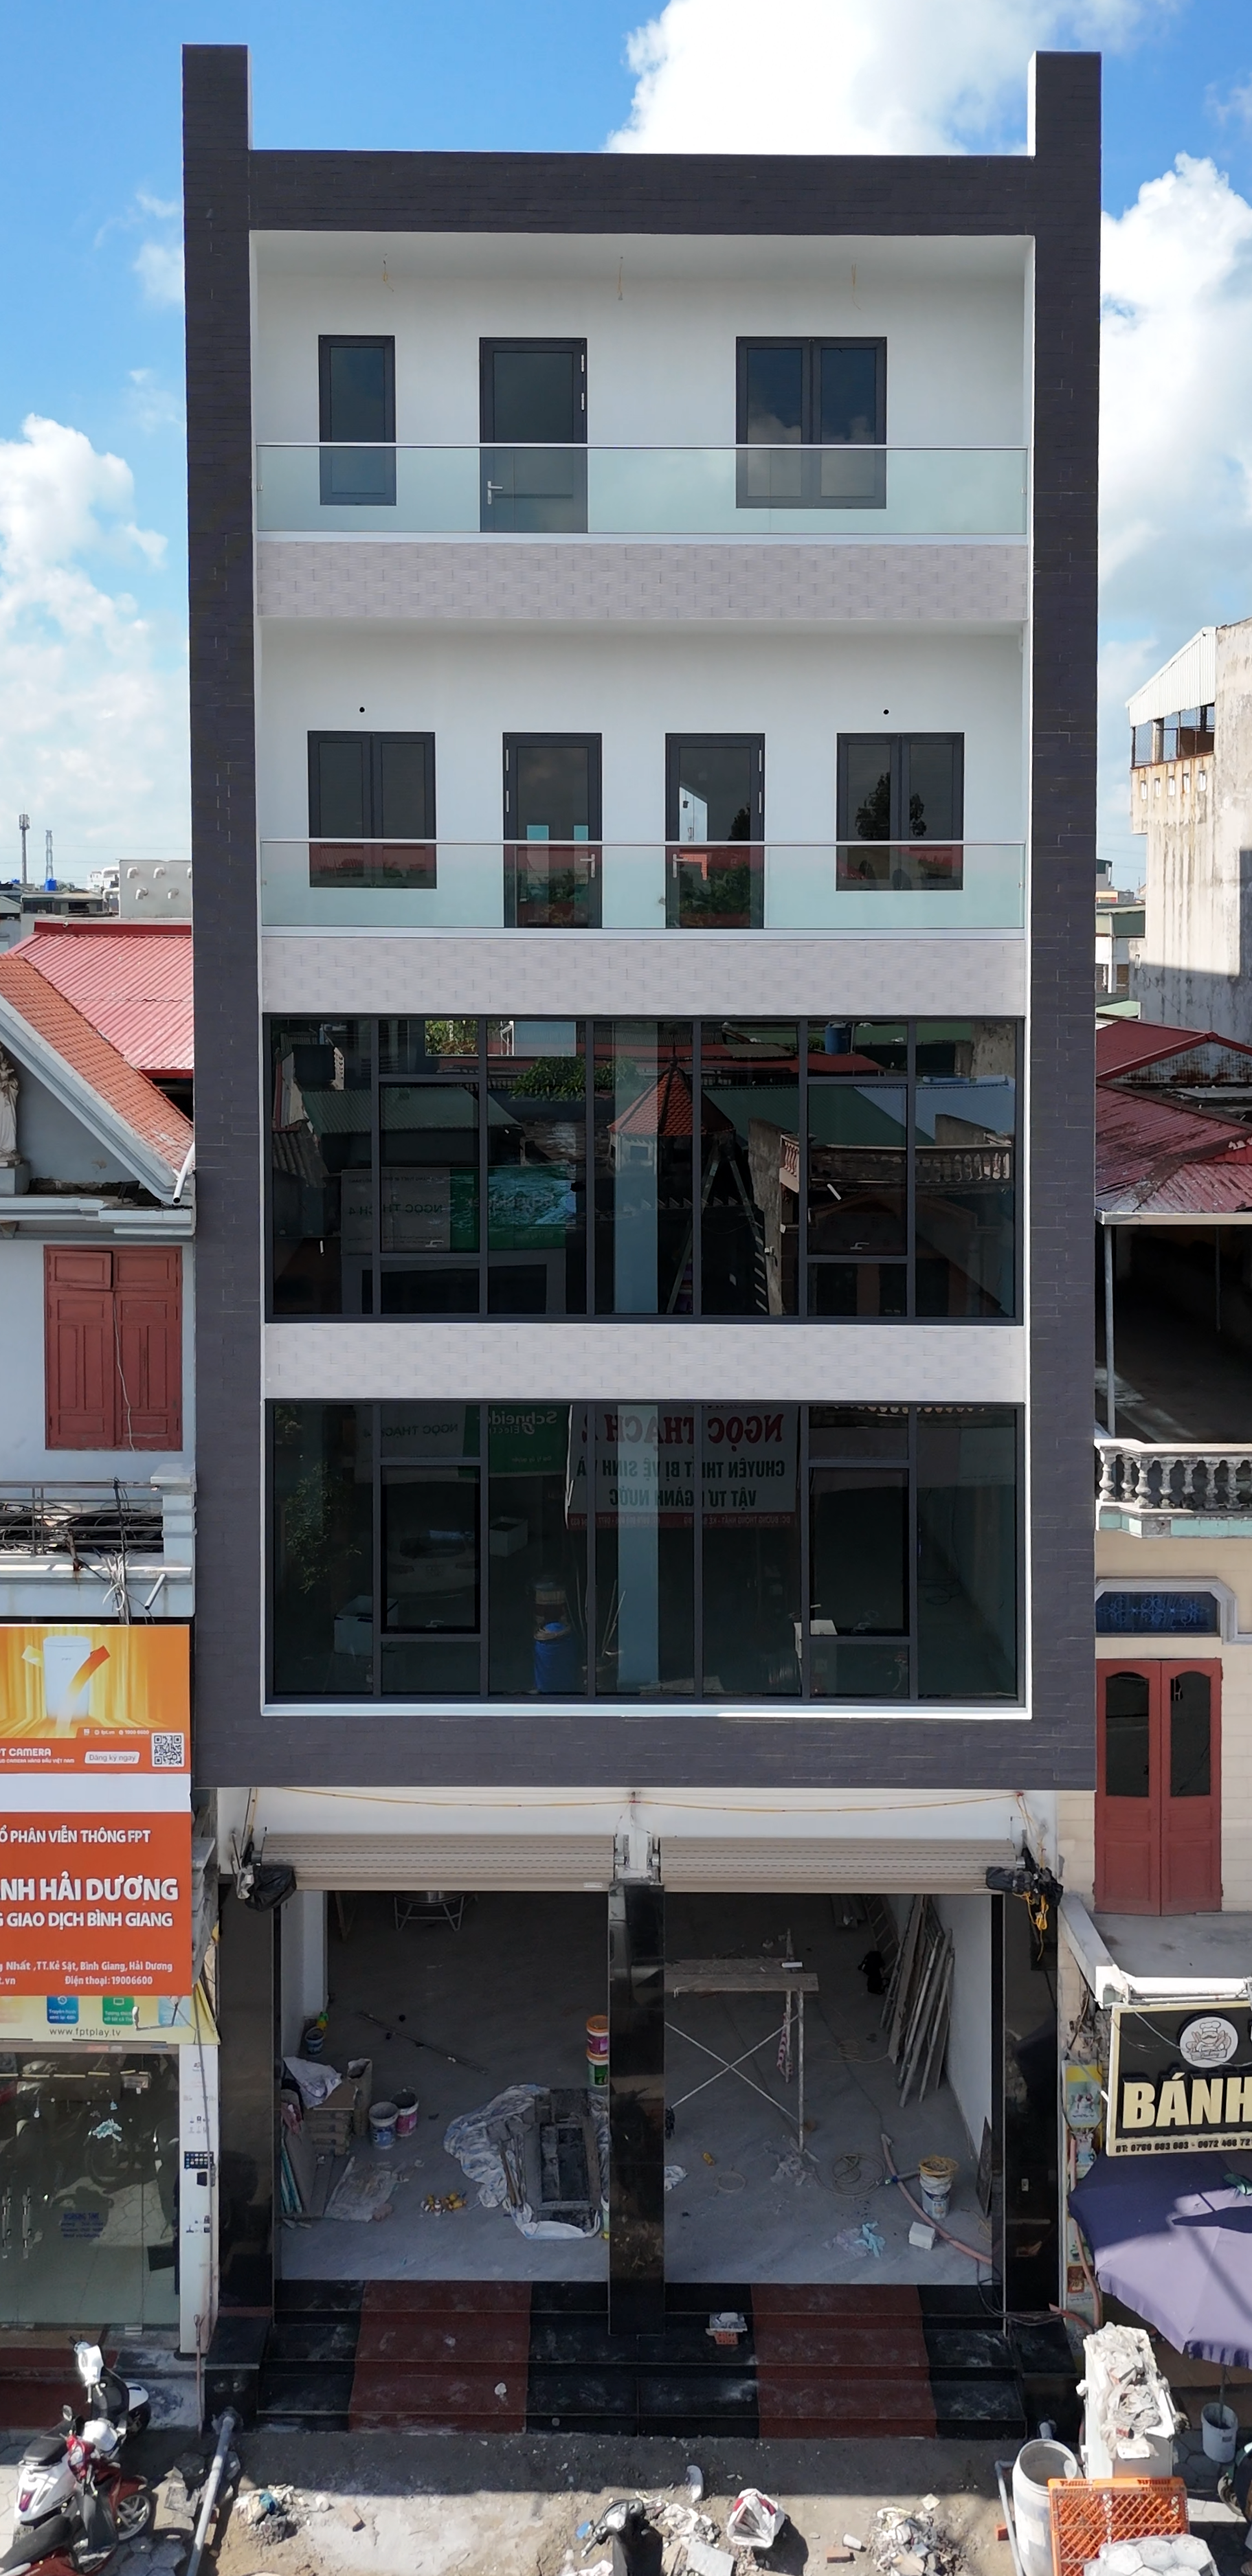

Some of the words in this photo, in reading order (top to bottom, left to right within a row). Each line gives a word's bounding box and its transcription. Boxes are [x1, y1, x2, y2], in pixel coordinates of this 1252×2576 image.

[0, 1748, 6, 1756] T
[9, 1748, 52, 1756] CAMERA
[48, 1824, 78, 1843] VIỄN
[80, 1827, 126, 1843] THÔNG
[128, 1829, 151, 1843] FPT
[0, 1878, 35, 1901] NH
[40, 1871, 81, 1901] HẢI
[86, 1875, 179, 1901] DƯƠNG
[7, 1912, 45, 1927] GIAO
[48, 1912, 85, 1930] DỊCH
[87, 1909, 122, 1927] BÌNH
[125, 1912, 173, 1927] GIANG
[6, 1960, 31, 1970] Nhất
[80, 1961, 99, 1970] Bình
[101, 1961, 128, 1972] Giang,
[129, 1960, 143, 1970] Hải
[145, 1961, 172, 1972] Dương
[65, 1976, 85, 1987] Điện
[85, 1976, 111, 1987] thoại:
[111, 1976, 153, 1985] 19006600
[49, 2027, 121, 2037] www.fptplay.tv
[1122, 2072, 1252, 2129] BÁNH
[1240, 2138, 1252, 2147] 72
